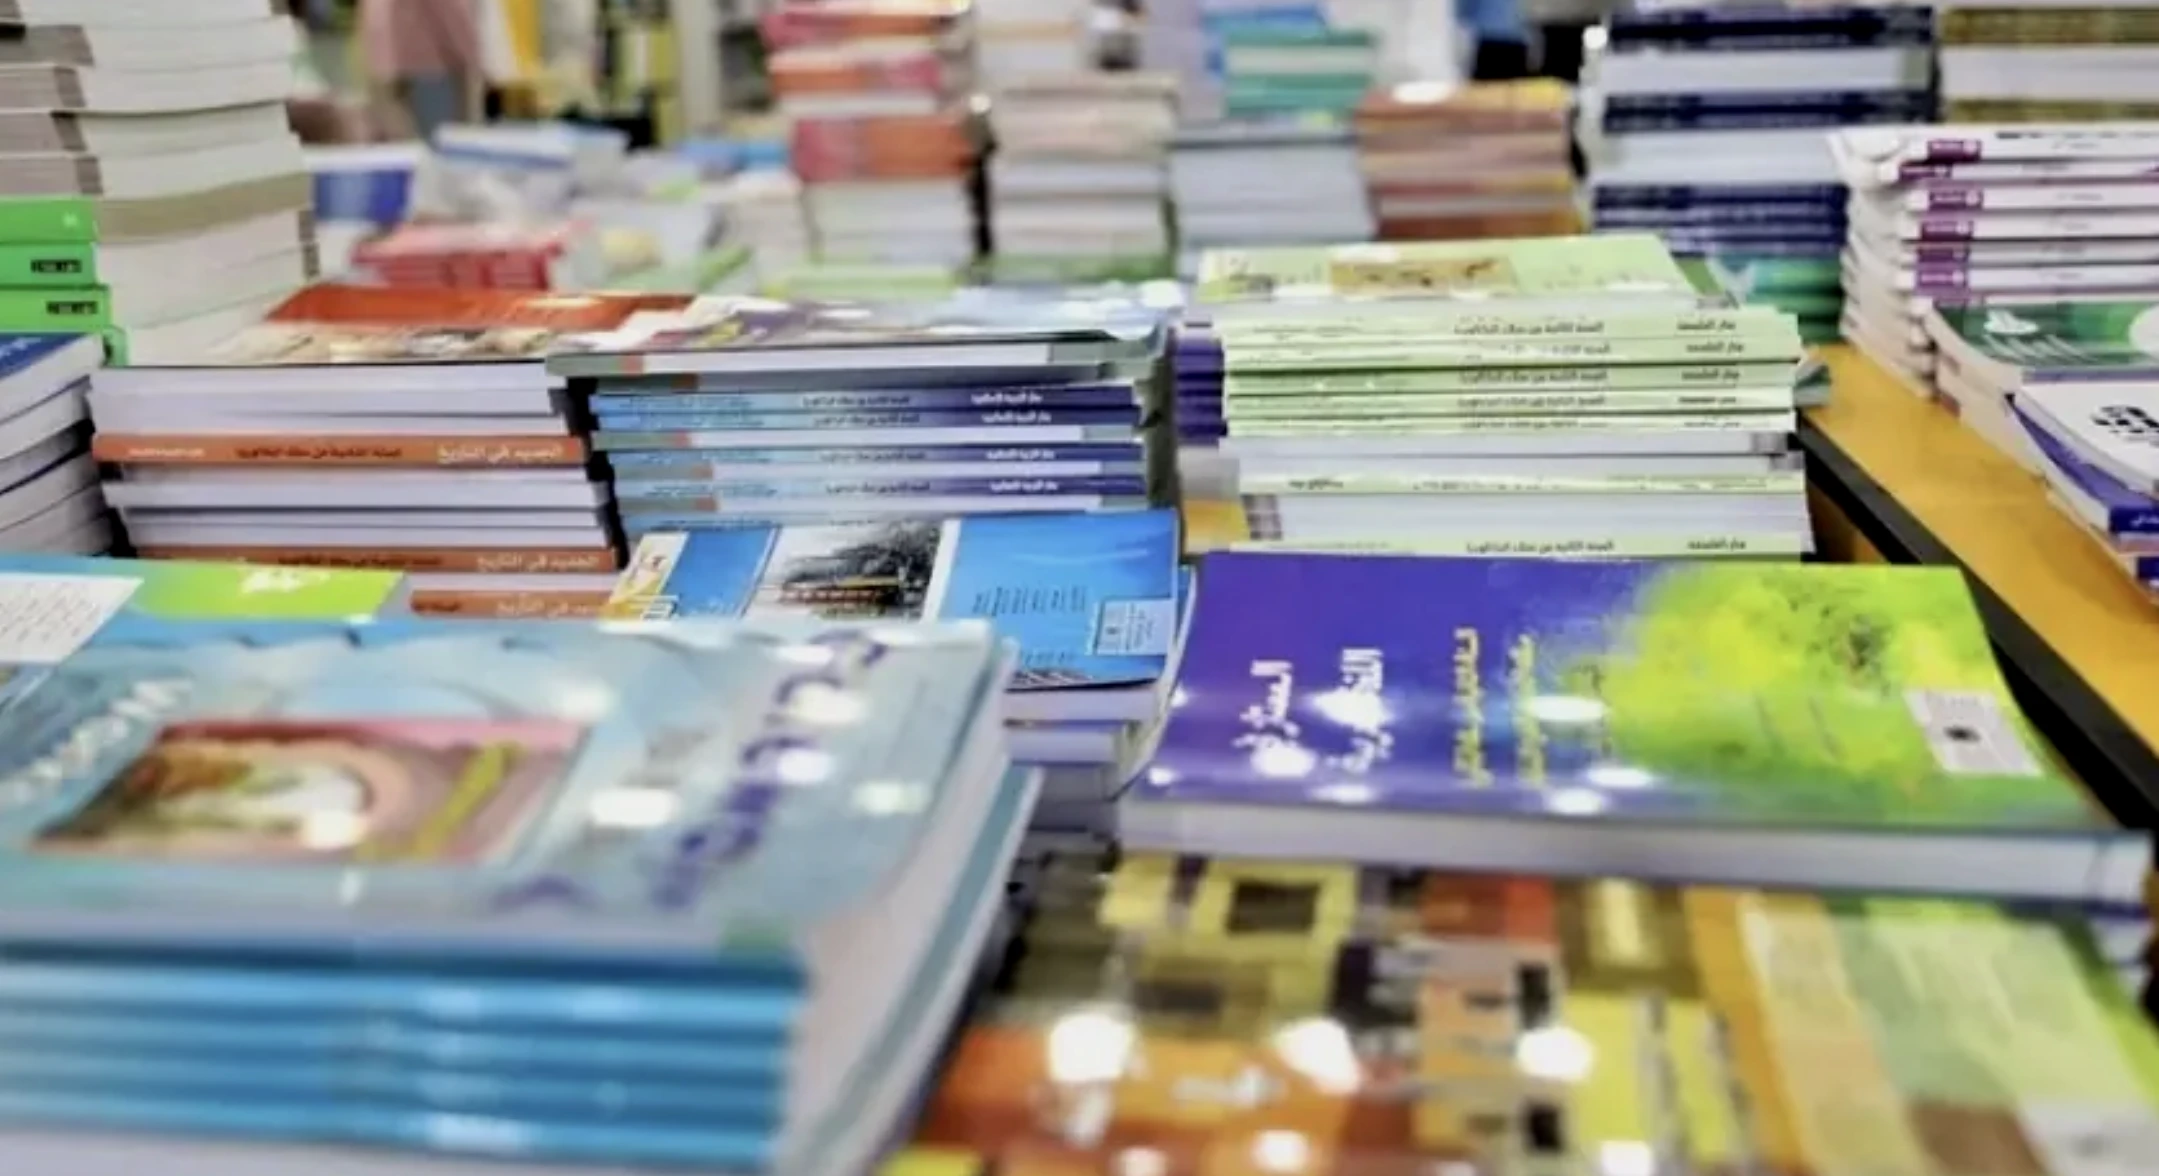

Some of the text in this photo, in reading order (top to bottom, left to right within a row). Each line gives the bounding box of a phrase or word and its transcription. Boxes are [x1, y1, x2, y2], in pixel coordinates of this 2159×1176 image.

[1574, 320, 1605, 333] السنة
[487, 443, 511, 464] في
[514, 440, 564, 461] الجديد
[1587, 539, 1613, 551] السنة
